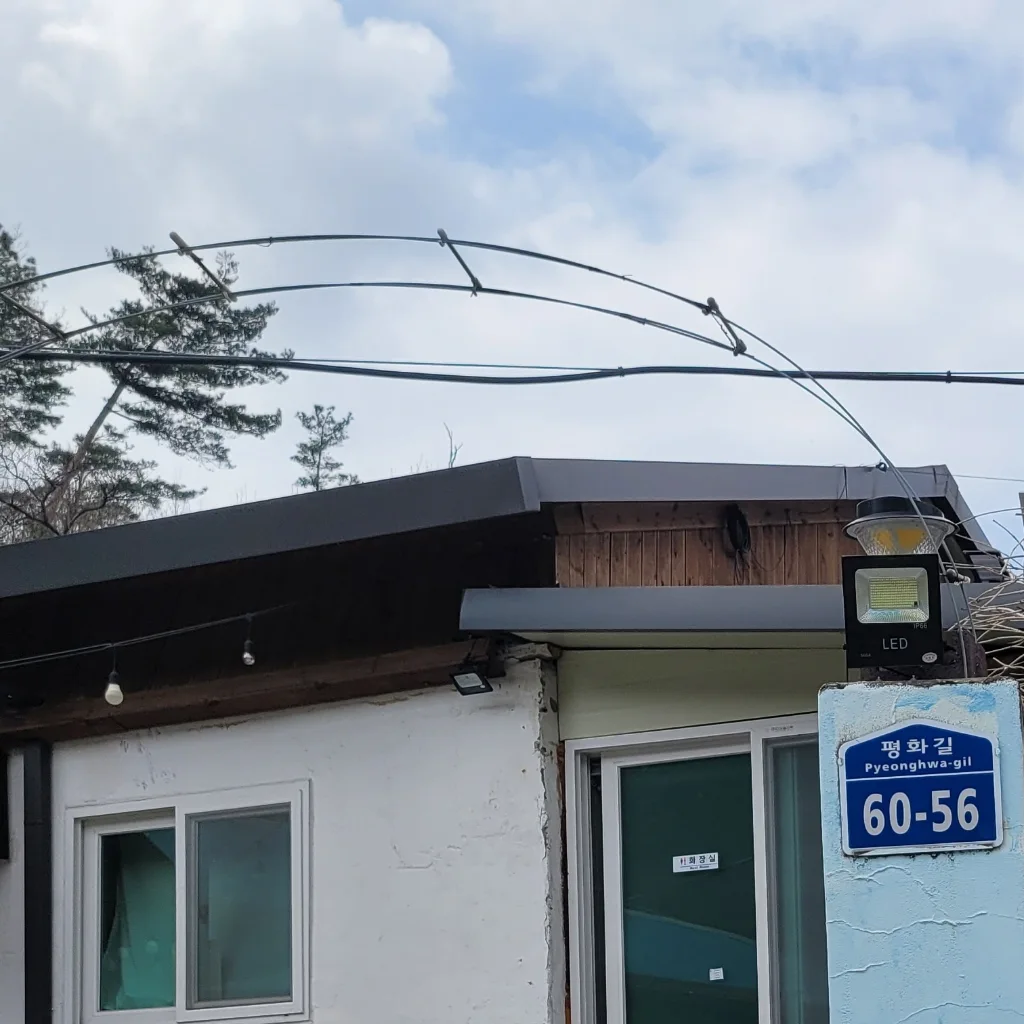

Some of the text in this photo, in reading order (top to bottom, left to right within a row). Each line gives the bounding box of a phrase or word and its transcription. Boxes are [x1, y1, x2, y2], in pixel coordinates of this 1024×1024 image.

[882, 637, 908, 650] LED
[881, 737, 953, 759] 평화길
[865, 756, 972, 774] Pyeonghwa-gil
[863, 788, 979, 836] 60-56
